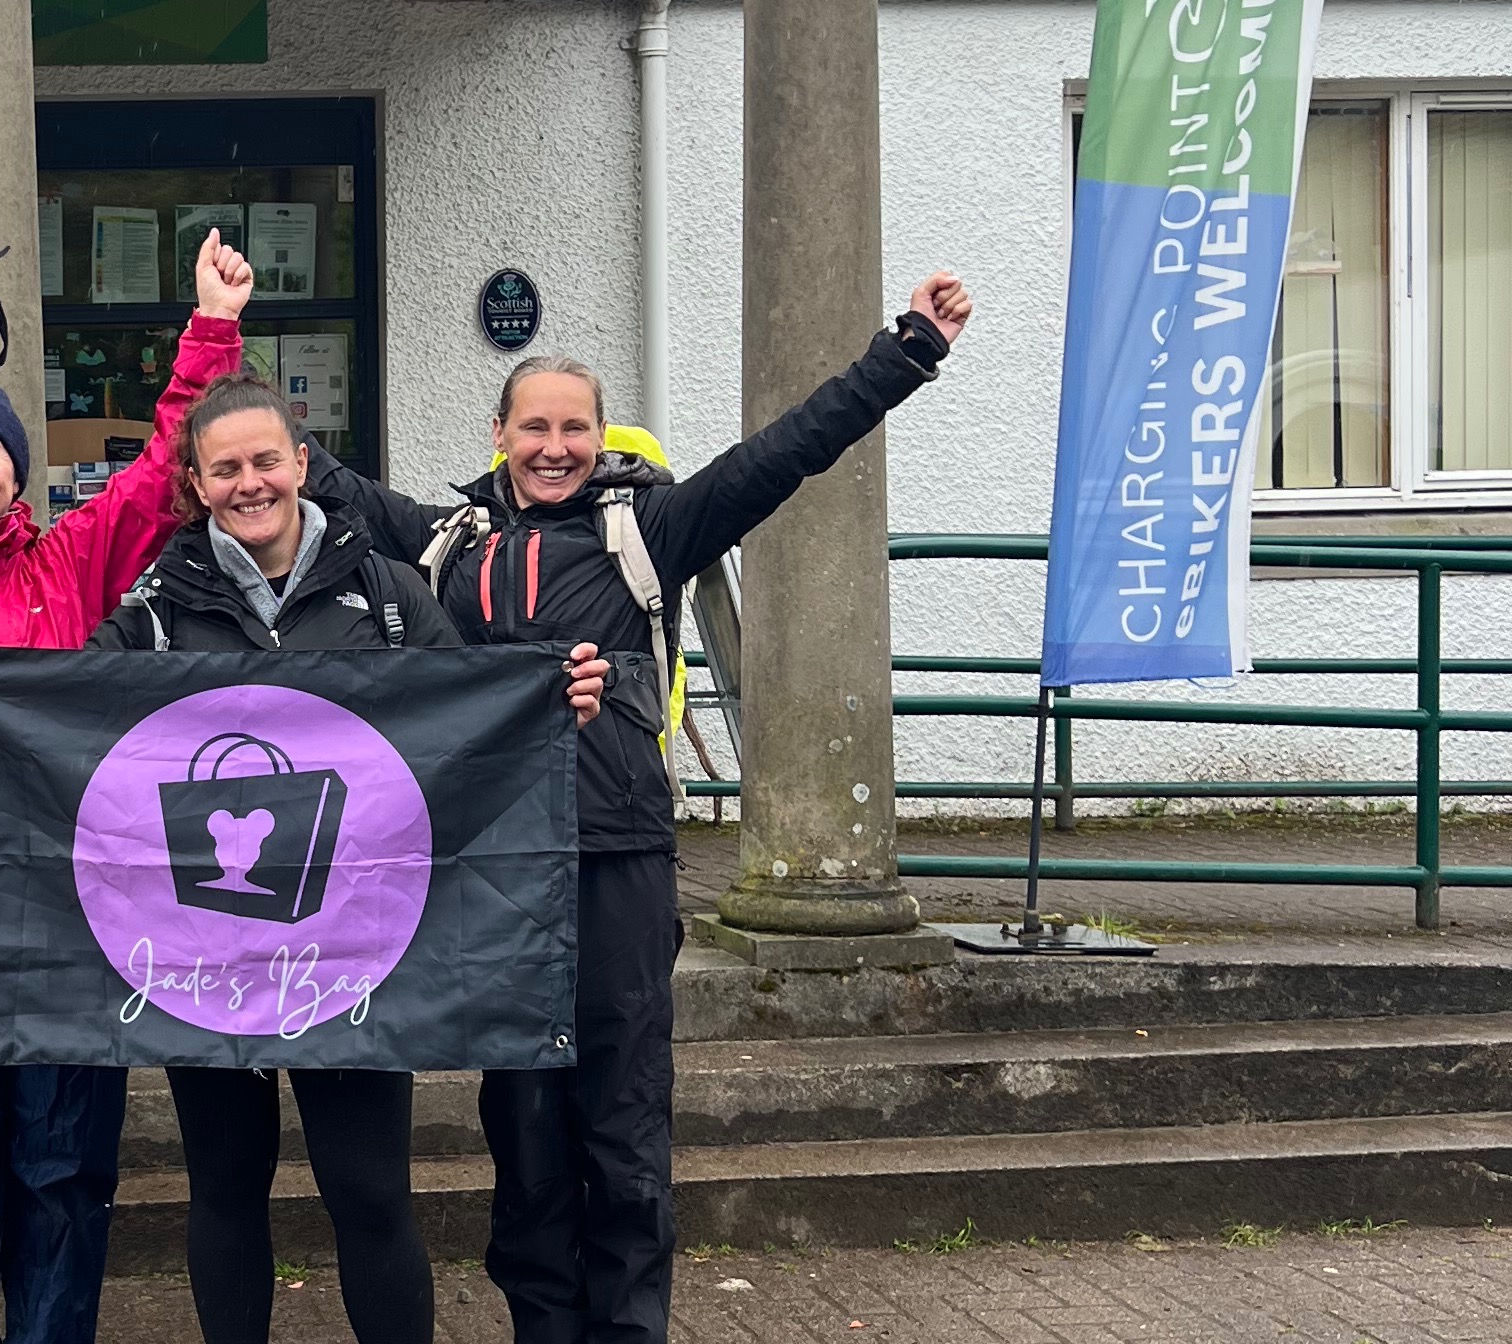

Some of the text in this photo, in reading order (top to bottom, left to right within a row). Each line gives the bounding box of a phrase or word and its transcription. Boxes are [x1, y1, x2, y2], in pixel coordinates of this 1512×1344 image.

[1152, 74, 1210, 275] POINT
[486, 296, 533, 309] Scottish
[1175, 354, 1246, 639] eBIKERS
[119, 937, 381, 1040] Jade's Bag
